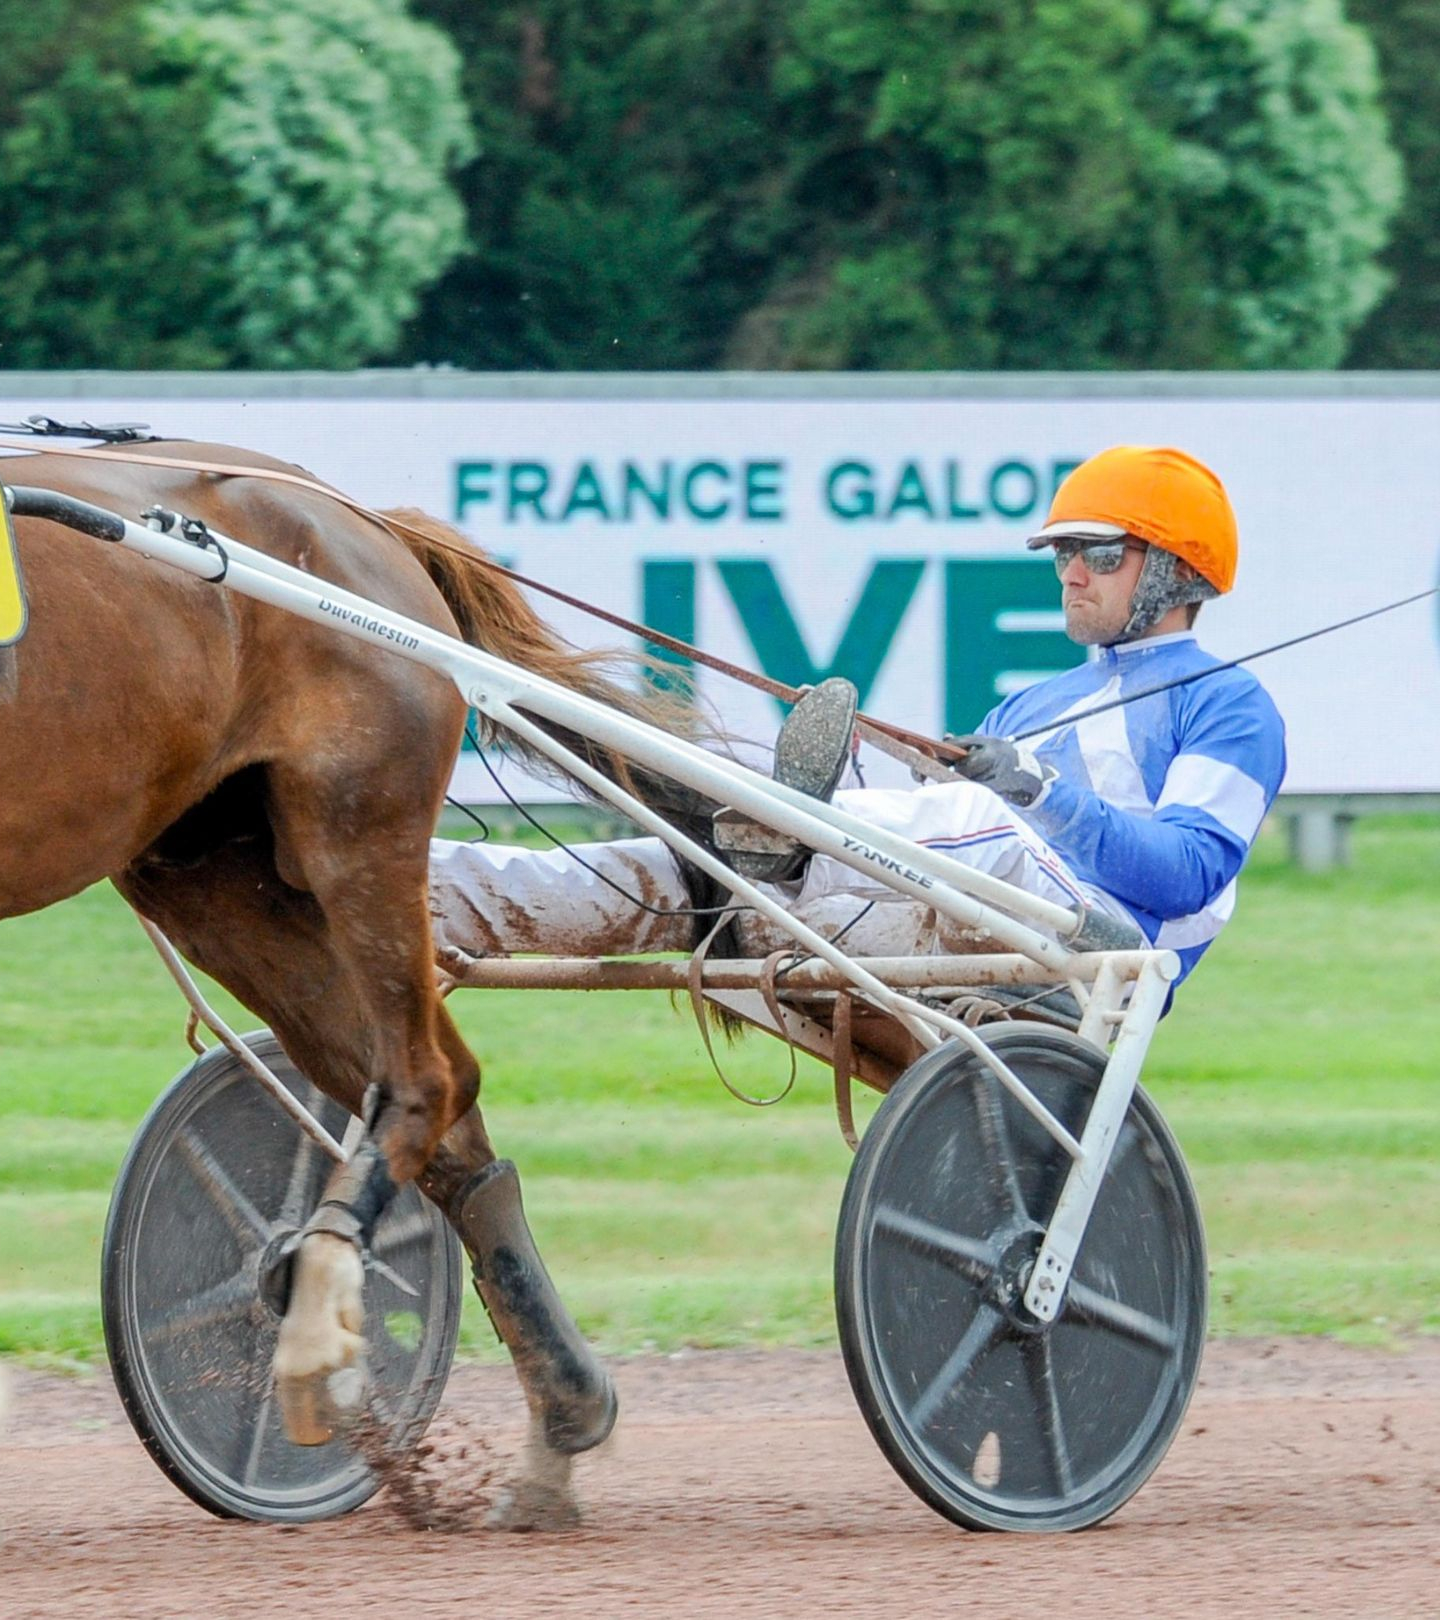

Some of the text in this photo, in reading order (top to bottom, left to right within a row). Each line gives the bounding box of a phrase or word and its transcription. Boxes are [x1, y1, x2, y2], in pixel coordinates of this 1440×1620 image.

[454, 459, 785, 522] FRANCE
[318, 599, 420, 650] Duvaldestin
[460, 556, 1090, 756] IVE
[843, 836, 933, 889] YANKEE
